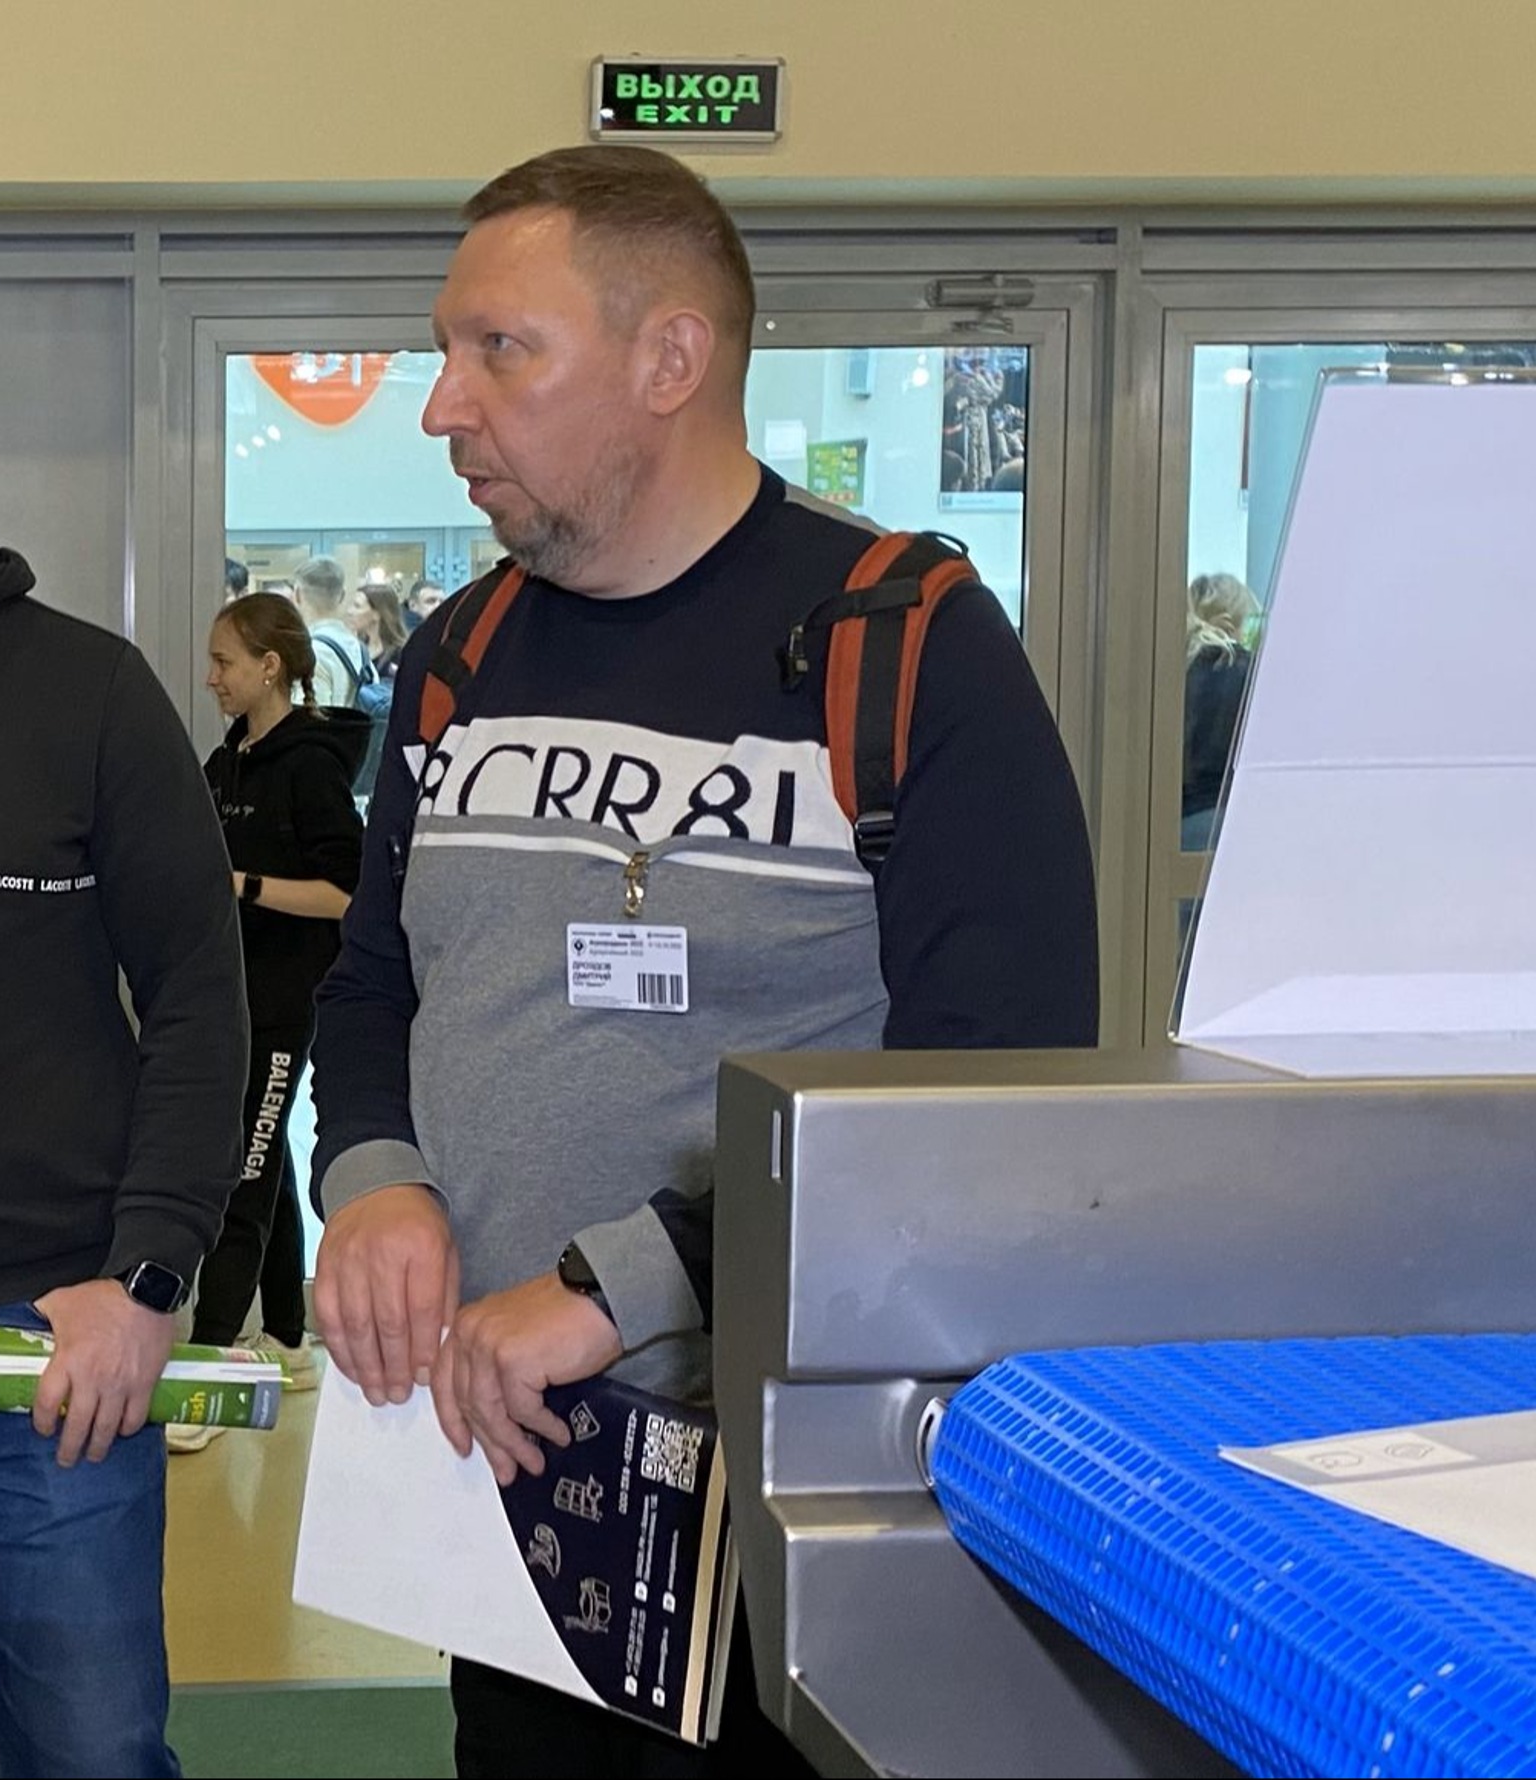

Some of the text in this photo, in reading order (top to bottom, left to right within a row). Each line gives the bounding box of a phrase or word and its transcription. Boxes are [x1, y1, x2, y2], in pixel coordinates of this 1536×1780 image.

[616, 73, 761, 104] ВЫХОД
[636, 104, 739, 123] EXIT
[241, 1051, 291, 1180] BALENCIAGA
